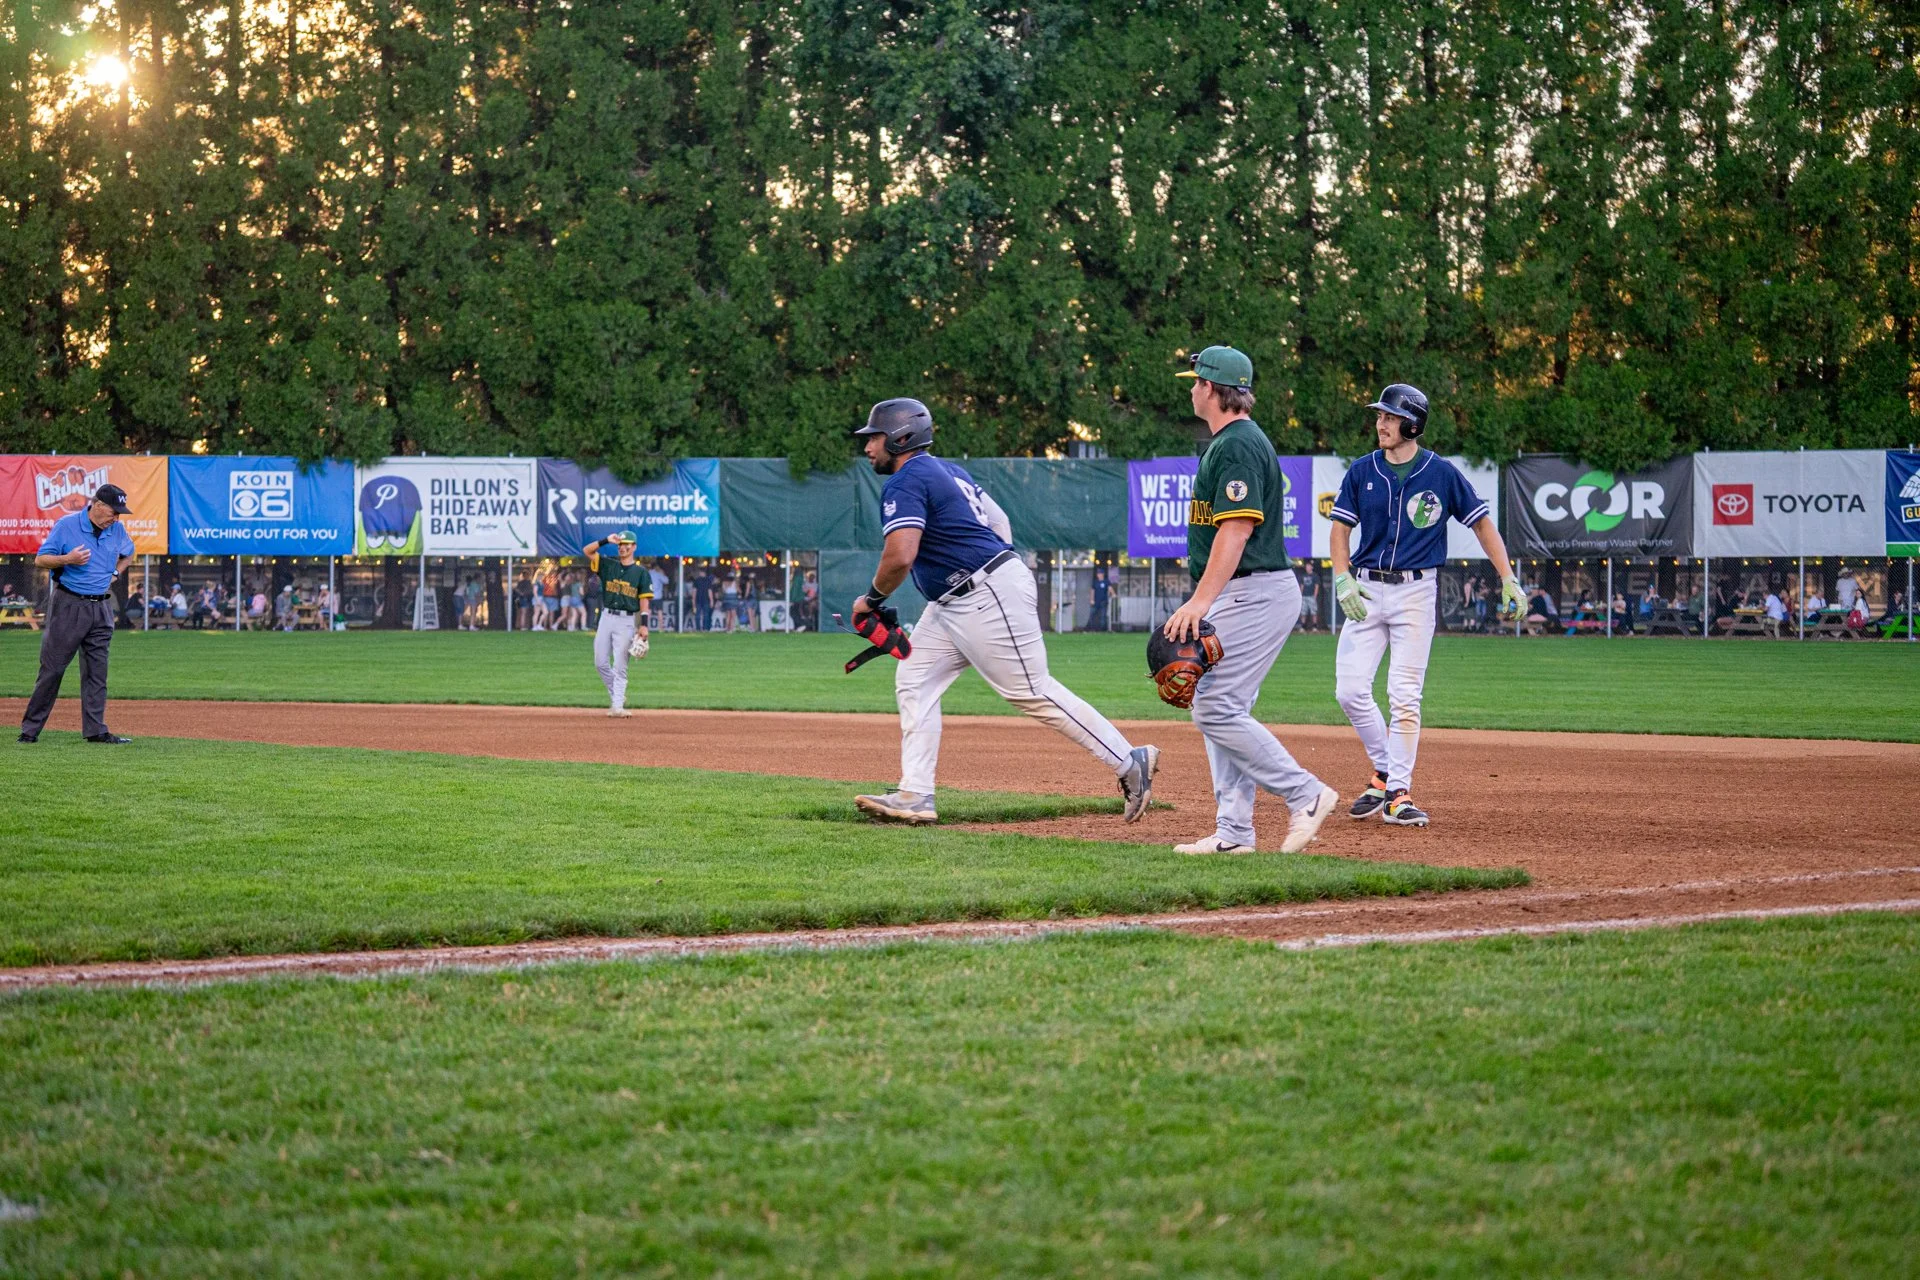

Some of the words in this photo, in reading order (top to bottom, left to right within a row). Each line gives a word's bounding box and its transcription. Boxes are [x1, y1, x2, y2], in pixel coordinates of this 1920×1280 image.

[237, 474, 287, 486] KOIN
[430, 478, 519, 496] DILLON'S
[260, 490, 290, 517] 6
[374, 484, 398, 510] P
[584, 488, 709, 511] Rivermark
[1283, 497, 1297, 510] EN
[1534, 480, 1666, 522] COR
[1763, 494, 1866, 513] TOYOTA
[430, 499, 531, 516] HIDEAWAY
[1319, 501, 1335, 518] up
[1905, 506, 1920, 519] GU
[0, 519, 18, 528] OUD
[20, 519, 55, 528] SPONSOR
[430, 518, 469, 535] BAR
[584, 515, 644, 527] community
[646, 515, 677, 525] credit
[679, 515, 709, 525] union
[184, 528, 251, 540] WATCHING
[253, 528, 280, 540] OUT
[283, 528, 308, 540] FOR
[311, 528, 338, 540] YOU
[1571, 539, 1608, 548] Premier
[1610, 539, 1638, 547] Waste
[1640, 538, 1673, 547] Partner
